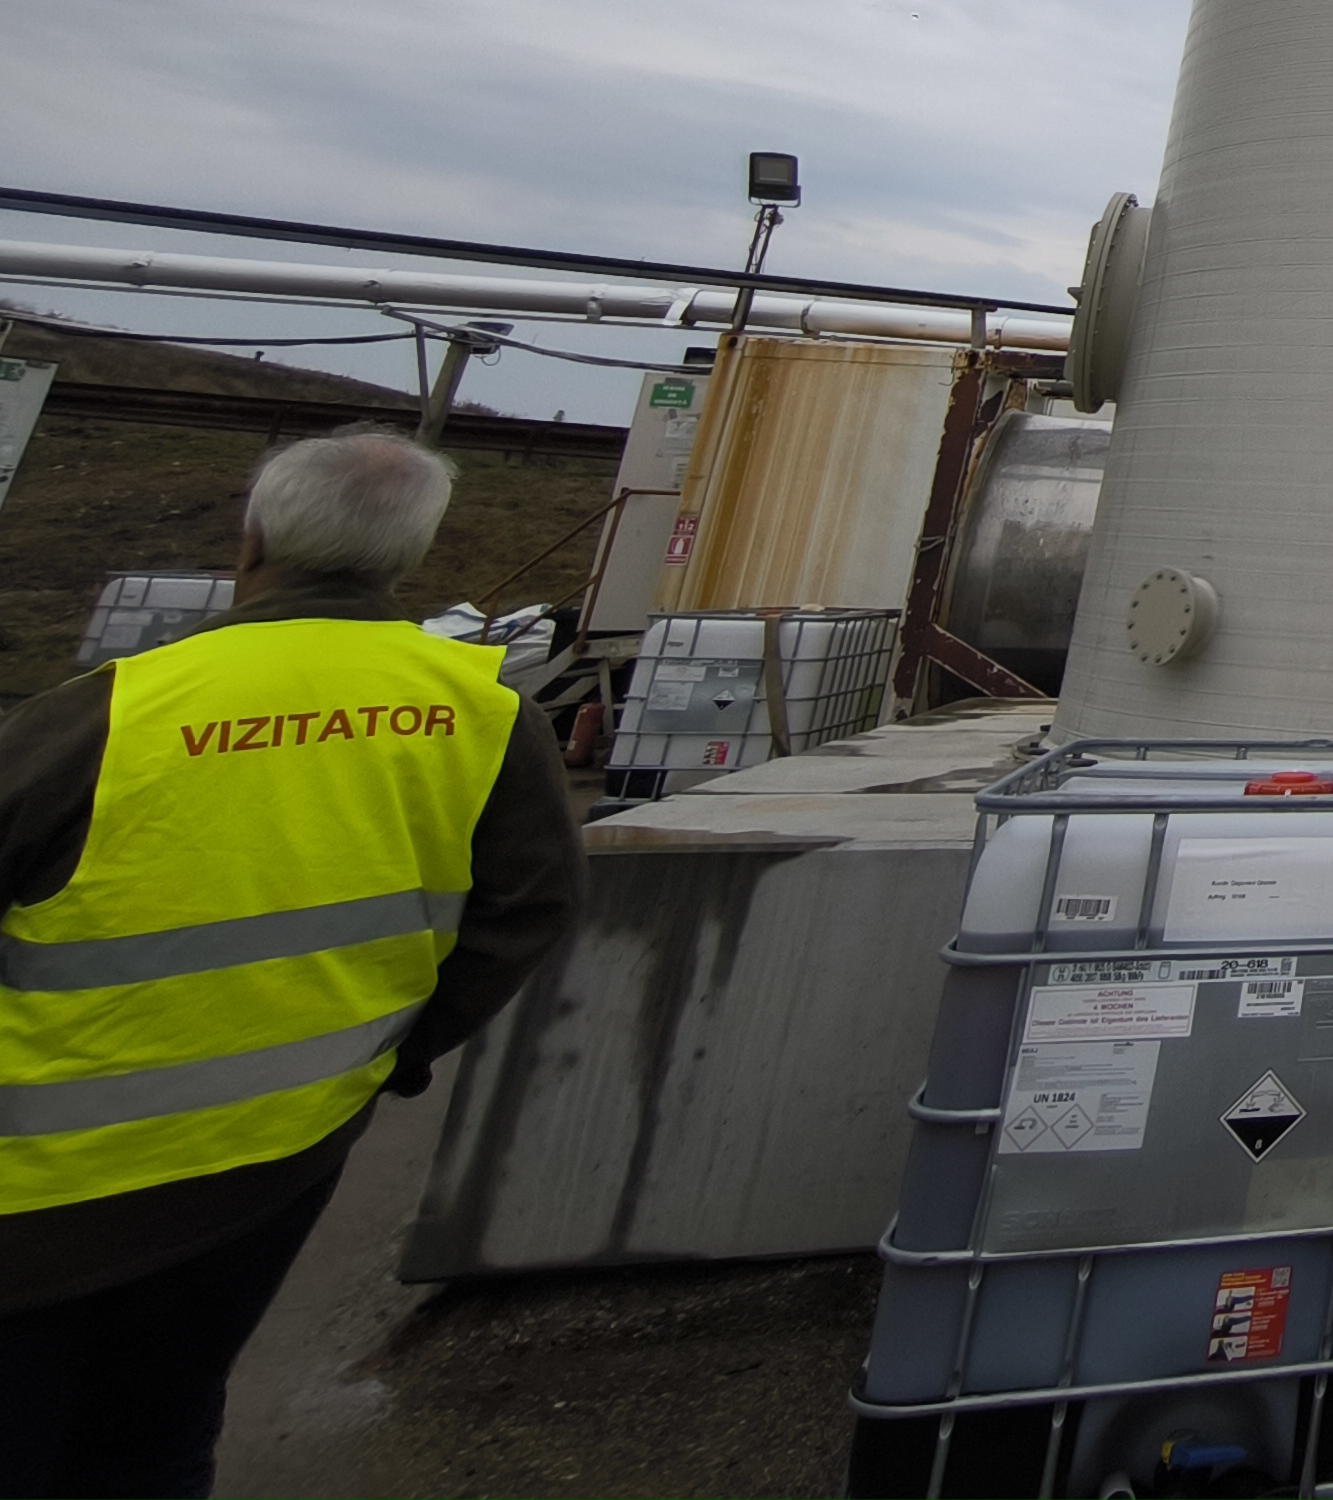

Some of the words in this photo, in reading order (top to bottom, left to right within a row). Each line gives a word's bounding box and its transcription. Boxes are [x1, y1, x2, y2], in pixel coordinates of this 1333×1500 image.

[180, 705, 456, 757] VIZITATOR
[1097, 989, 1133, 997] ACHTUNG
[1033, 1093, 1049, 1103] UN
[1052, 1092, 1076, 1102] 1824
[1255, 1139, 1263, 1149] 8
